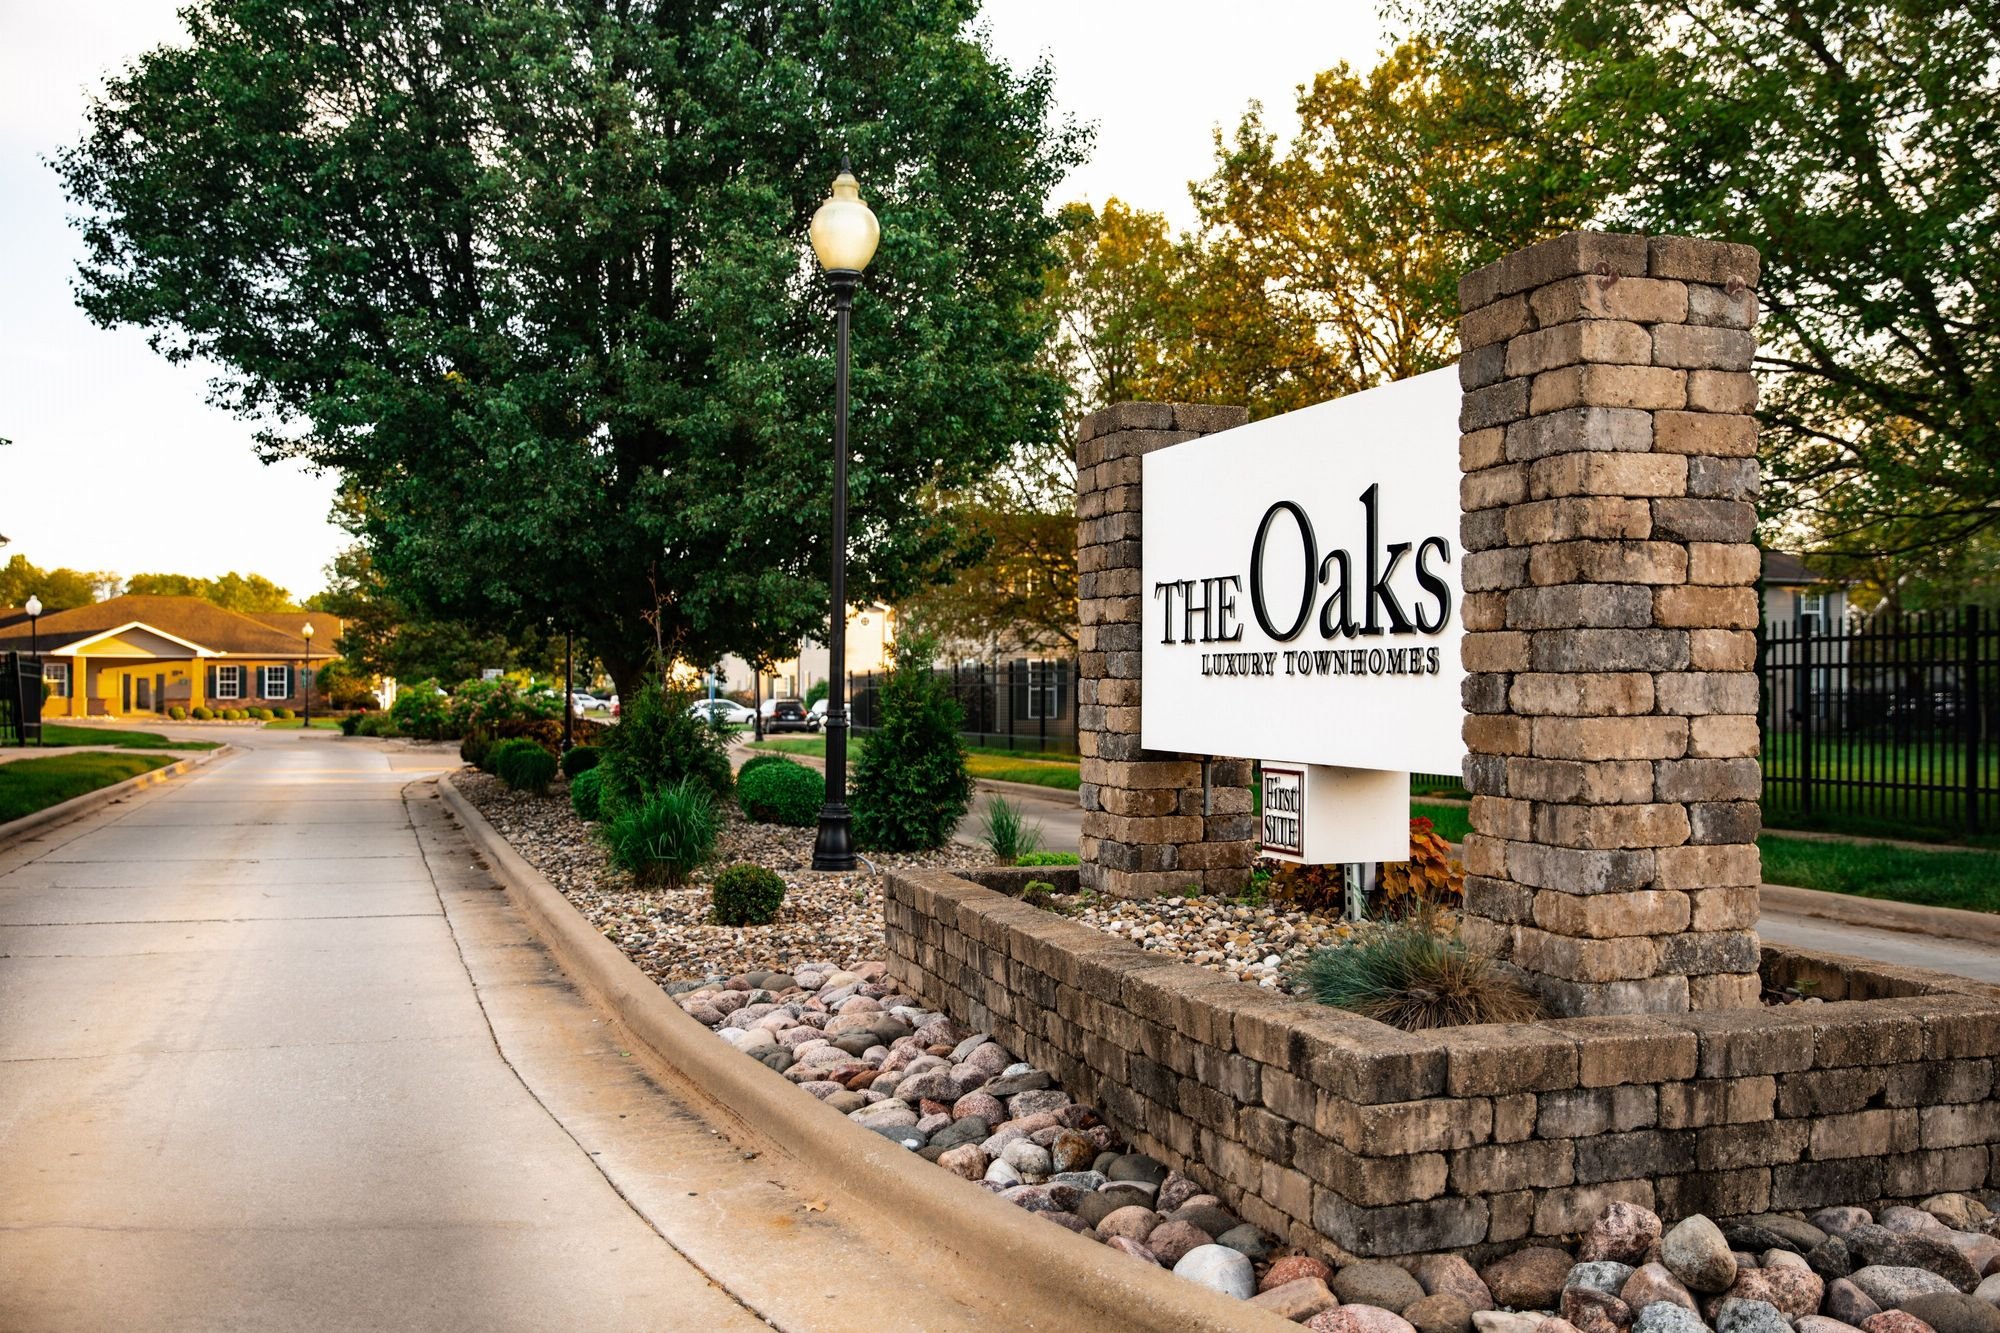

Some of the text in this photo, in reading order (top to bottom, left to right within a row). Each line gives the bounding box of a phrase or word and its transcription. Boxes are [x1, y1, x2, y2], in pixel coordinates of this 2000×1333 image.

[1154, 482, 1452, 645] THE Oaks
[1201, 646, 1440, 676] LUXURY TOWNHOMES
[1265, 776, 1299, 814] First
[1264, 814, 1298, 847] SITE
